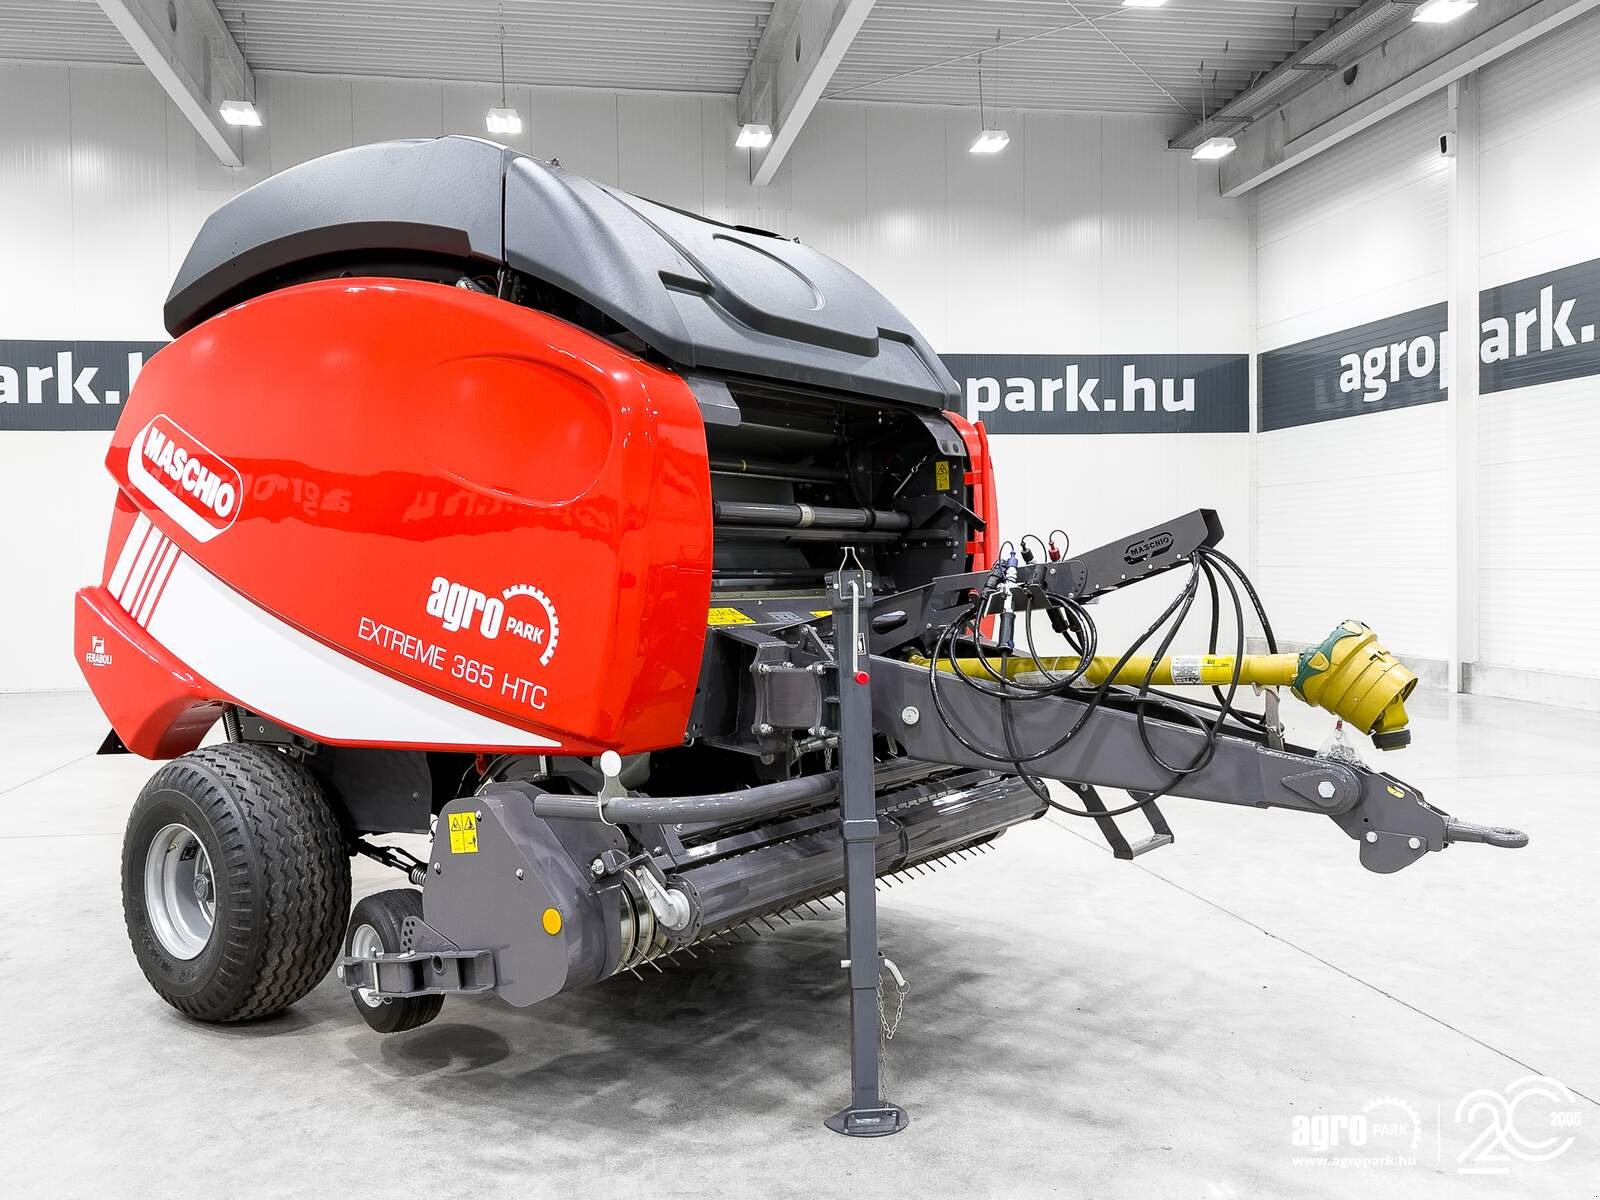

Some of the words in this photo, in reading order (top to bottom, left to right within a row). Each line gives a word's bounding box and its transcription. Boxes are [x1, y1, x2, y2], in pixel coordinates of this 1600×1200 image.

[952, 364, 1195, 425] park.hu
[144, 426, 235, 517] MASCHIO
[1130, 536, 1169, 556] MASCHIO
[426, 576, 504, 639] agro
[505, 616, 544, 644] PARK
[358, 617, 447, 671] EXTREME
[451, 654, 494, 689] 365
[501, 673, 548, 710] HTC
